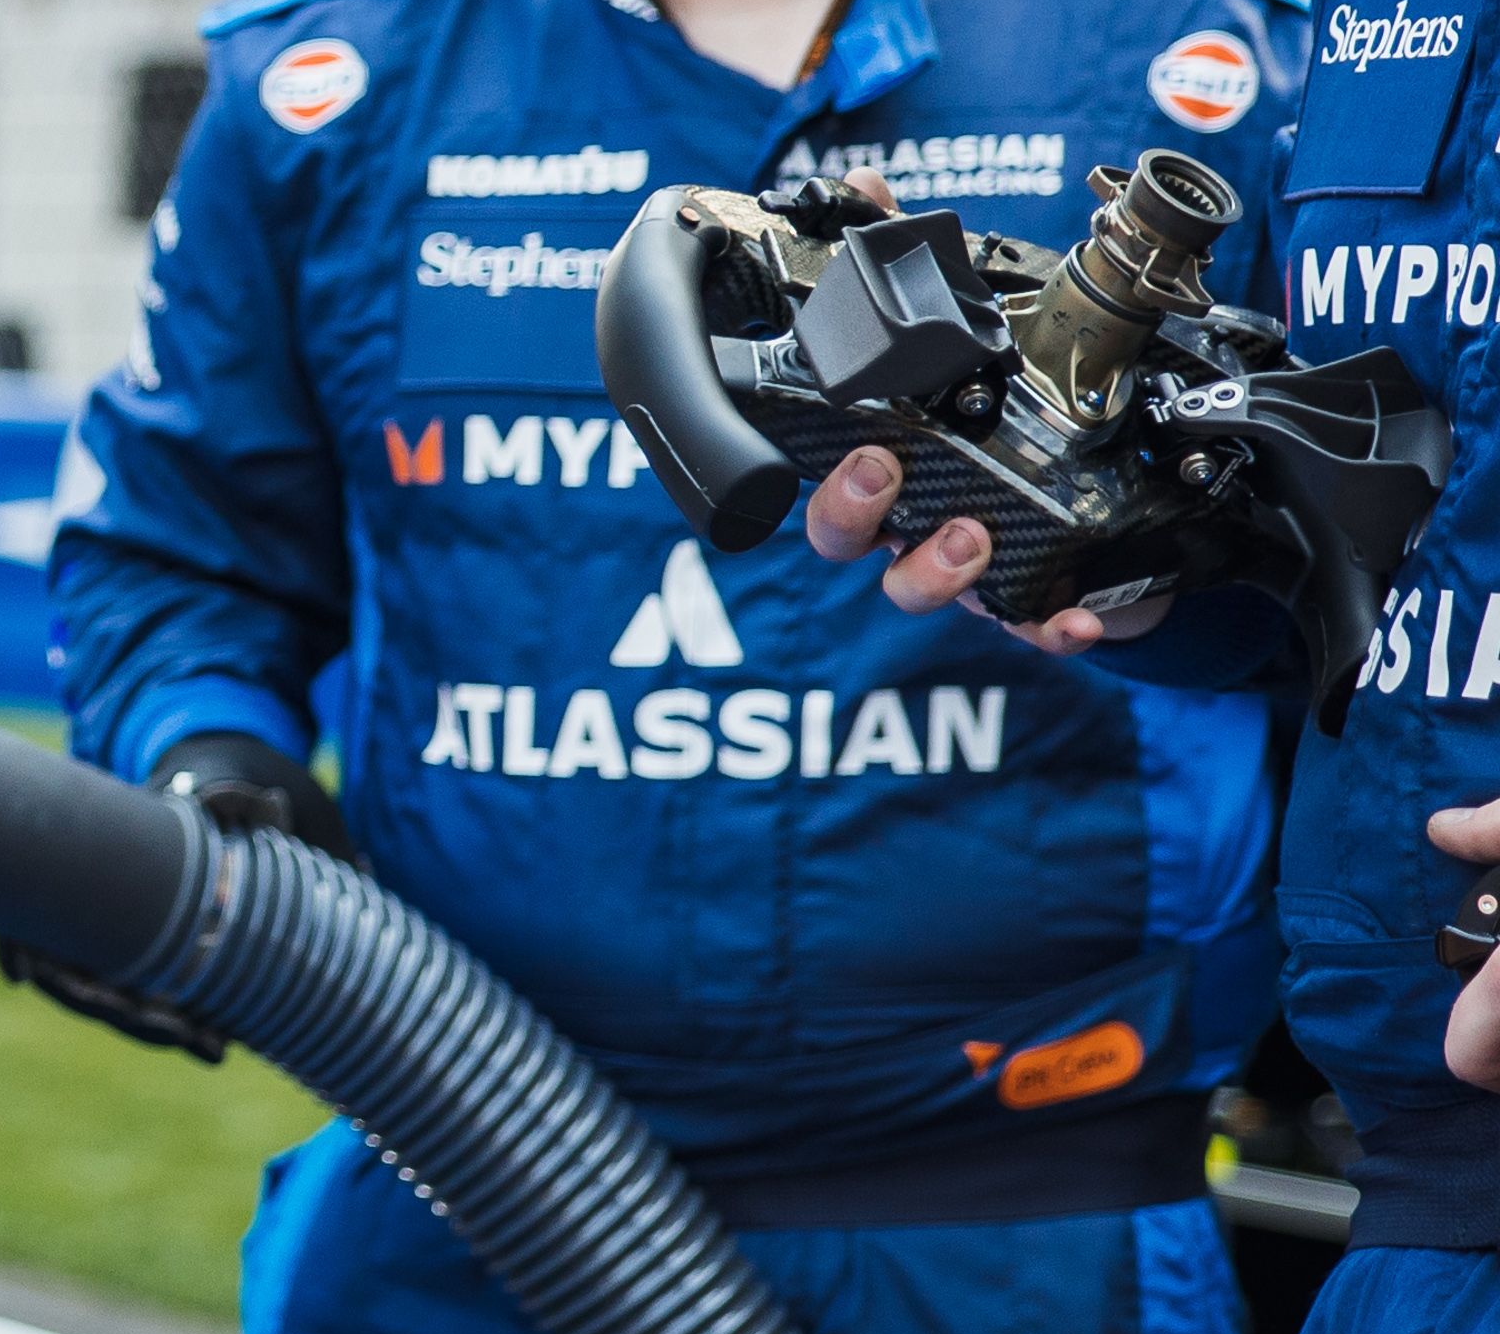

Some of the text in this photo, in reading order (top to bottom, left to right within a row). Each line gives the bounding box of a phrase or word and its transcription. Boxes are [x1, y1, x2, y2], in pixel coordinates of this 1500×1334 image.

[427, 145, 649, 198] KOMATSU
[417, 232, 610, 297] Stephen
[422, 683, 1007, 780] ATLASSIAN
